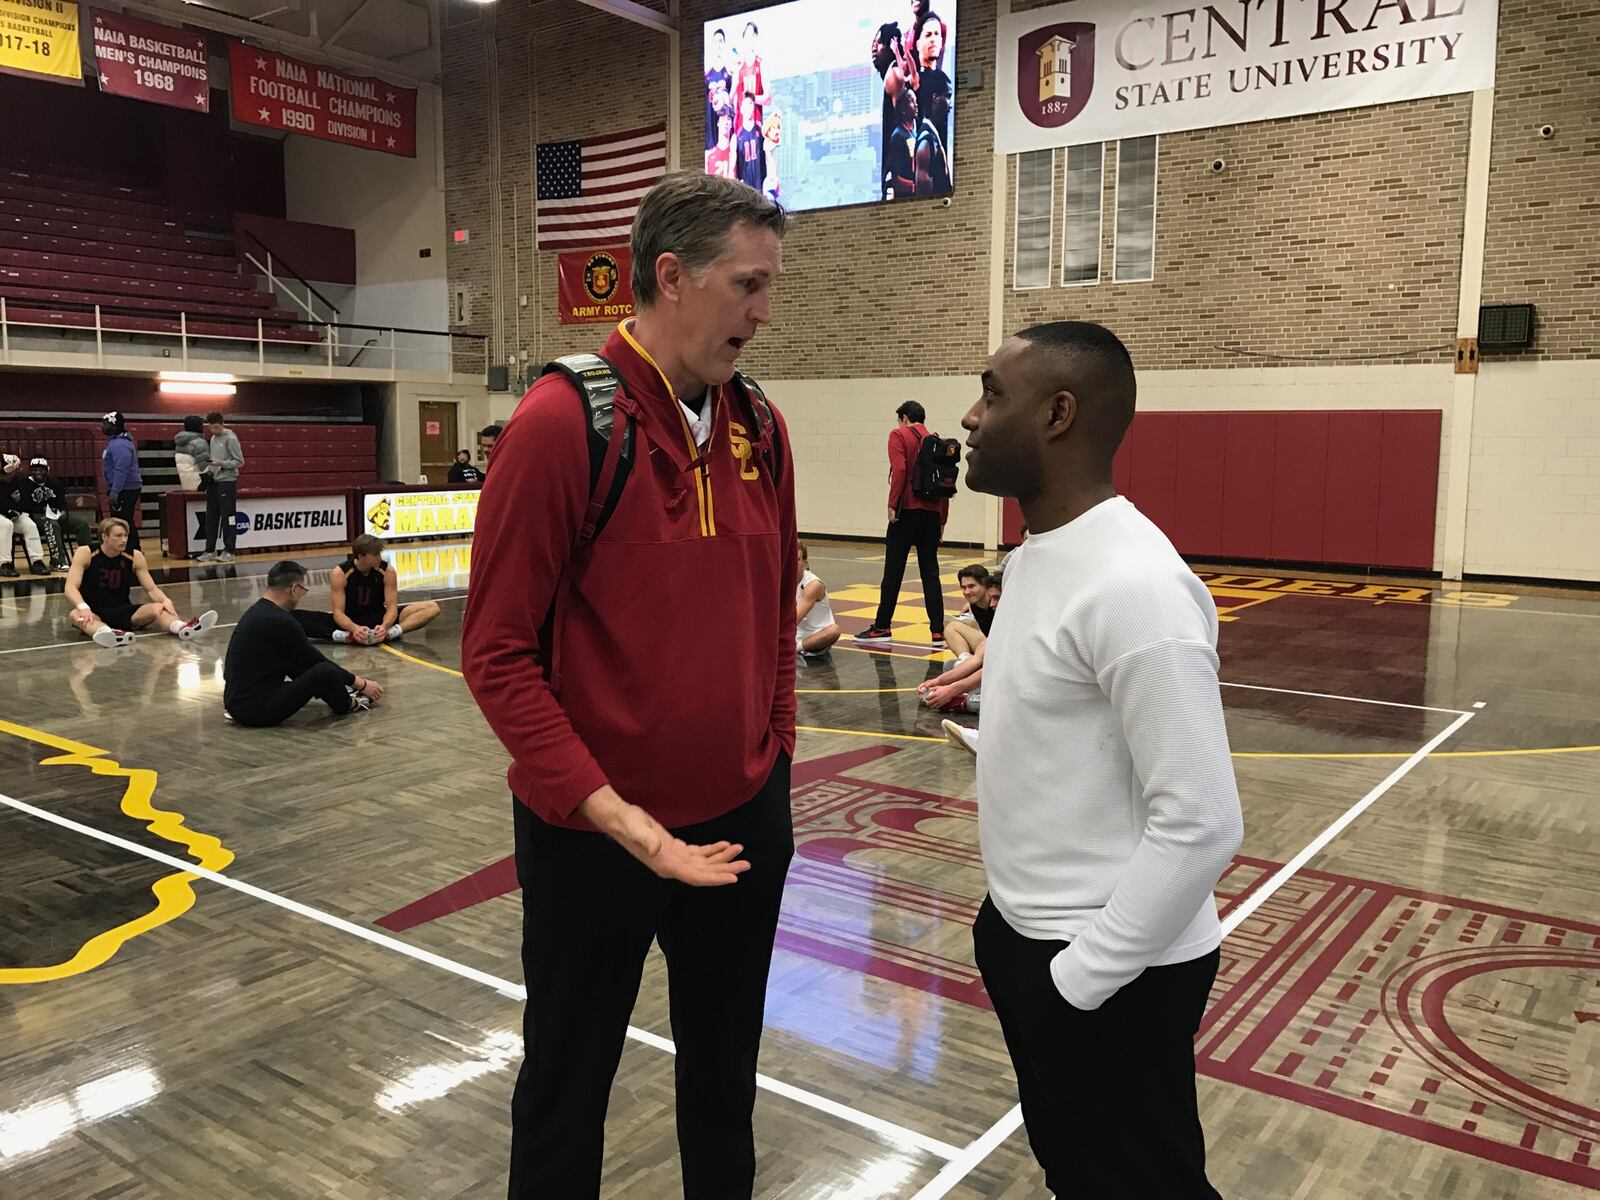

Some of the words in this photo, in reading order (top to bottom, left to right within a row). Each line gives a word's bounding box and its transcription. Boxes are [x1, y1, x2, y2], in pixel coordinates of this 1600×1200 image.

[7, 21, 53, 38] BASKETBALL
[33, 16, 75, 31] CHAMPIONS
[94, 27, 126, 46] NAIA
[129, 34, 207, 64] BASKETBALL
[95, 45, 135, 64] MEN'S
[138, 54, 207, 80] CHAMPIONS
[1115, 73, 1211, 111] STATE
[1228, 33, 1464, 93] UNIVERSITY
[134, 69, 174, 91] 1968
[276, 59, 308, 84] NAIA
[317, 70, 379, 101] NATIONAL
[250, 76, 321, 110] FOOTBALL
[329, 97, 401, 128] CHAMPIONS
[1041, 101, 1068, 115] 1887
[281, 108, 315, 131] 1990
[328, 120, 368, 141] DIVISION
[572, 306, 601, 317] ARMY
[604, 304, 632, 315] ROTC
[582, 369, 611, 377] TROJANS
[395, 494, 449, 506] CENTRAL
[253, 509, 343, 531] BASKETBALL
[395, 506, 477, 534] MARA
